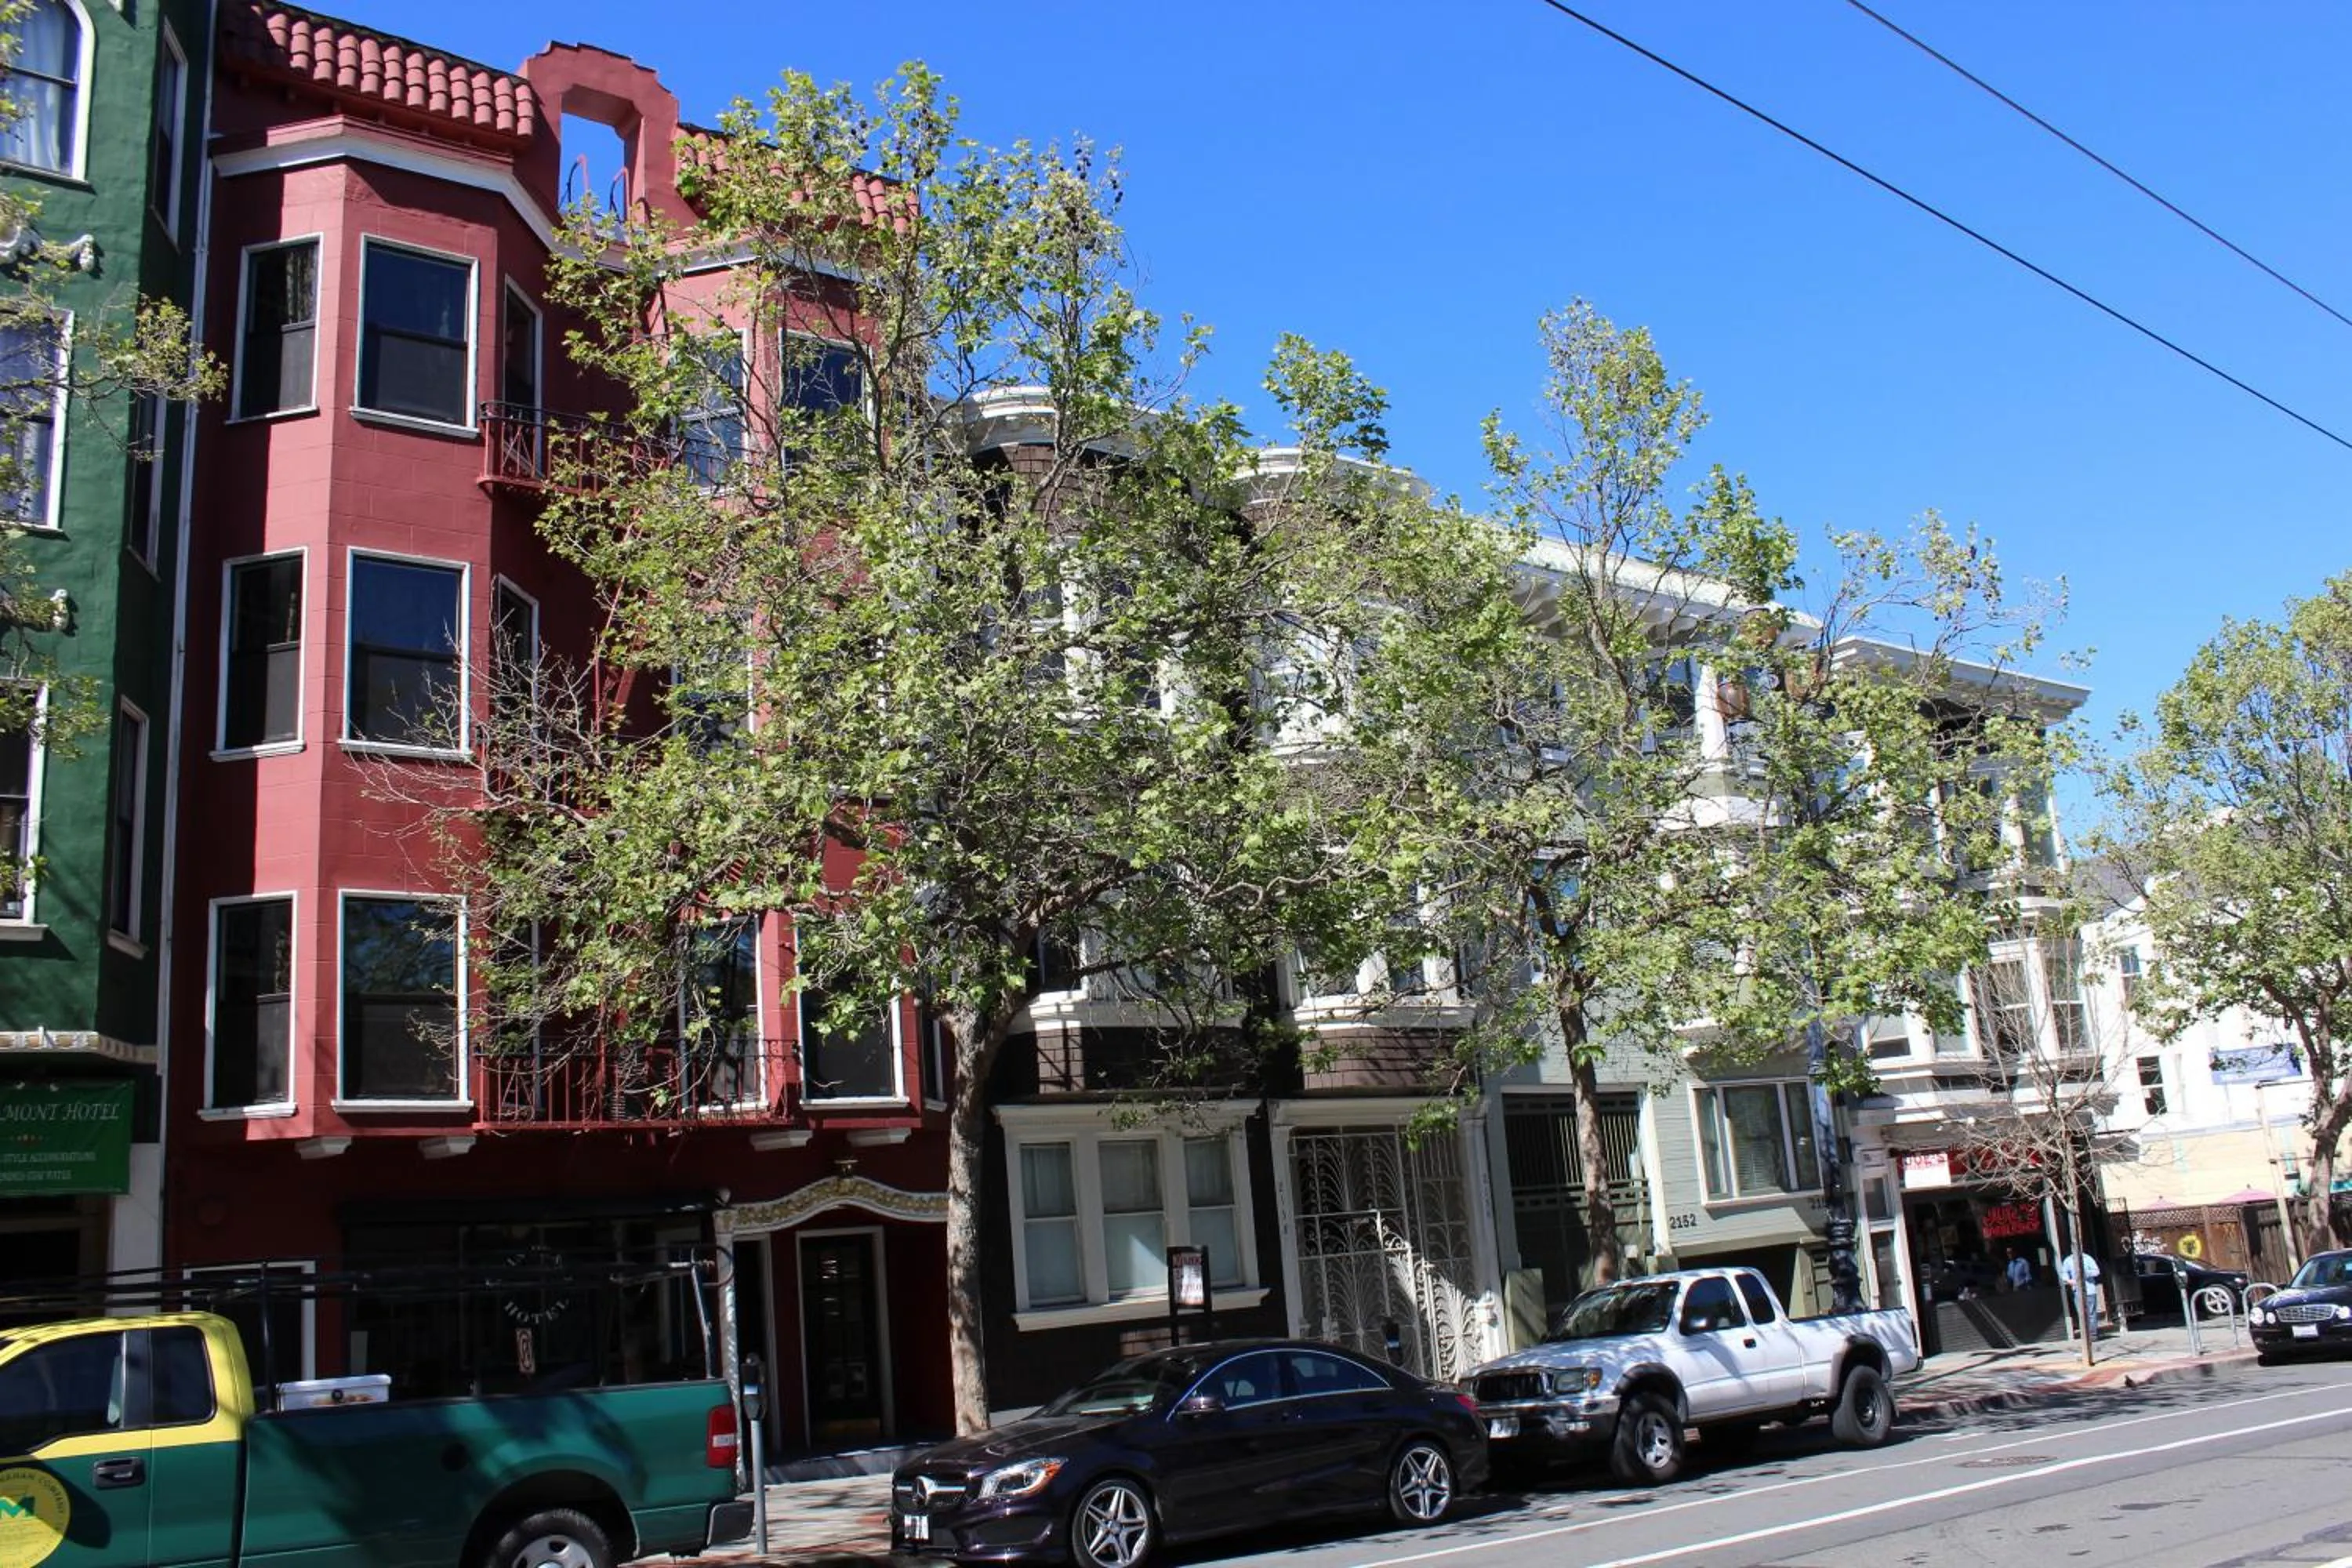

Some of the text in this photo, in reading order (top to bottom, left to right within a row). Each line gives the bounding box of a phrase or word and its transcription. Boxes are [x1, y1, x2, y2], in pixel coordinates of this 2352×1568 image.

[0, 1102, 120, 1121] MONT HOTEL
[1669, 1213, 1697, 1230] 2152
[503, 1298, 570, 1325] HOTEL
